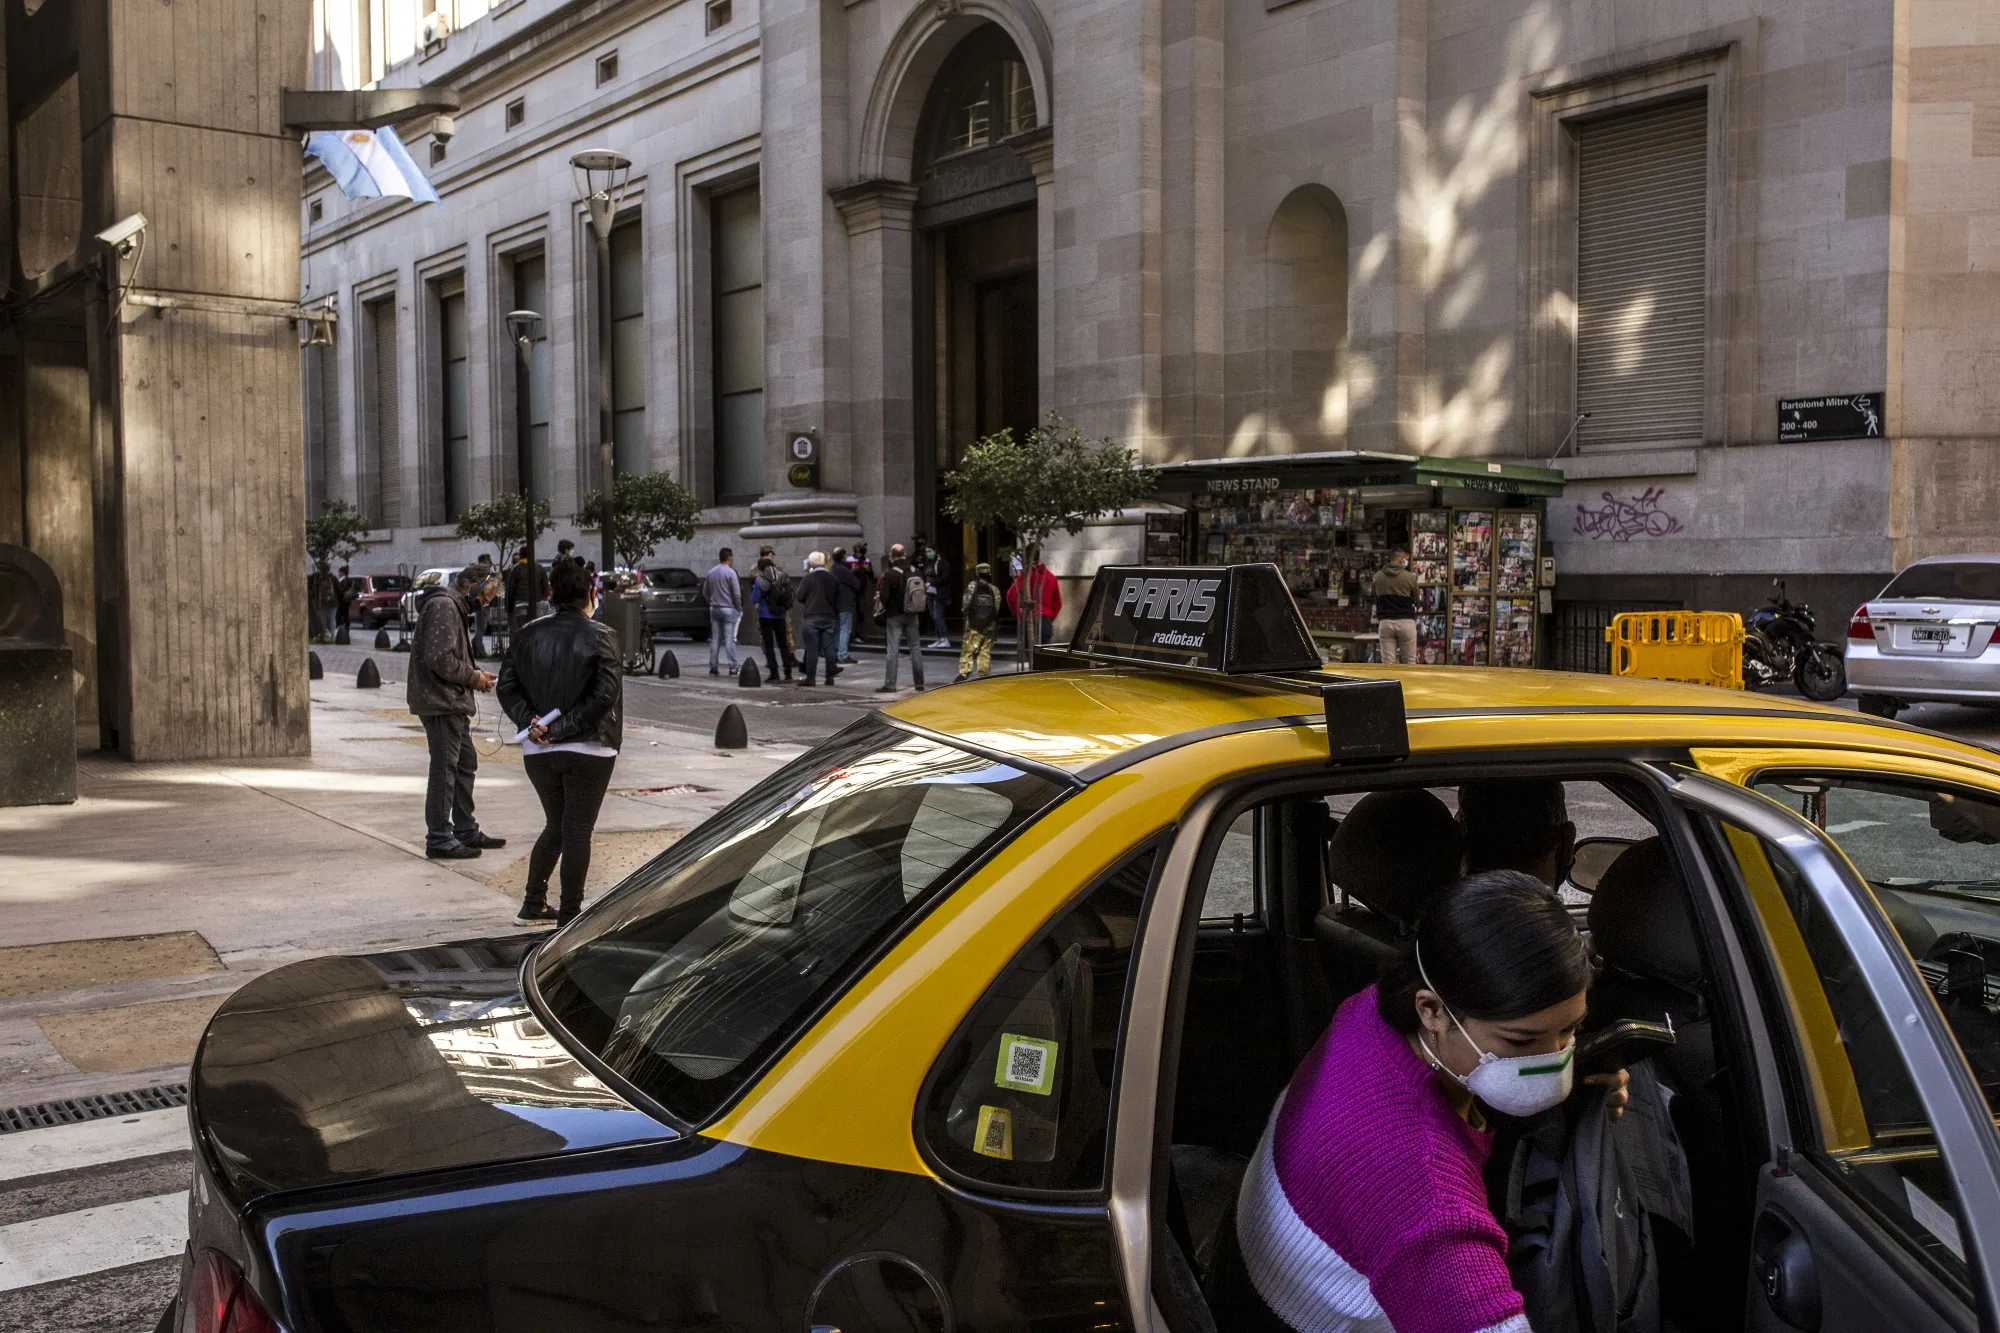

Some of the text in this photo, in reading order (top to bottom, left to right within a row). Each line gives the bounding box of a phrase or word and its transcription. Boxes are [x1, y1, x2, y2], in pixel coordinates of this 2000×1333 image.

[1781, 397, 1849, 410] Bartolomé Mitre
[1781, 421, 1796, 431] 300
[1802, 420, 1818, 429] 400
[1206, 477, 1280, 491] NEWS STAND
[1463, 478, 1520, 492] NEWS STAND
[1114, 577, 1222, 623] PARIS
[1152, 629, 1206, 648] radiotaxi
[1912, 630, 1928, 641] NMH
